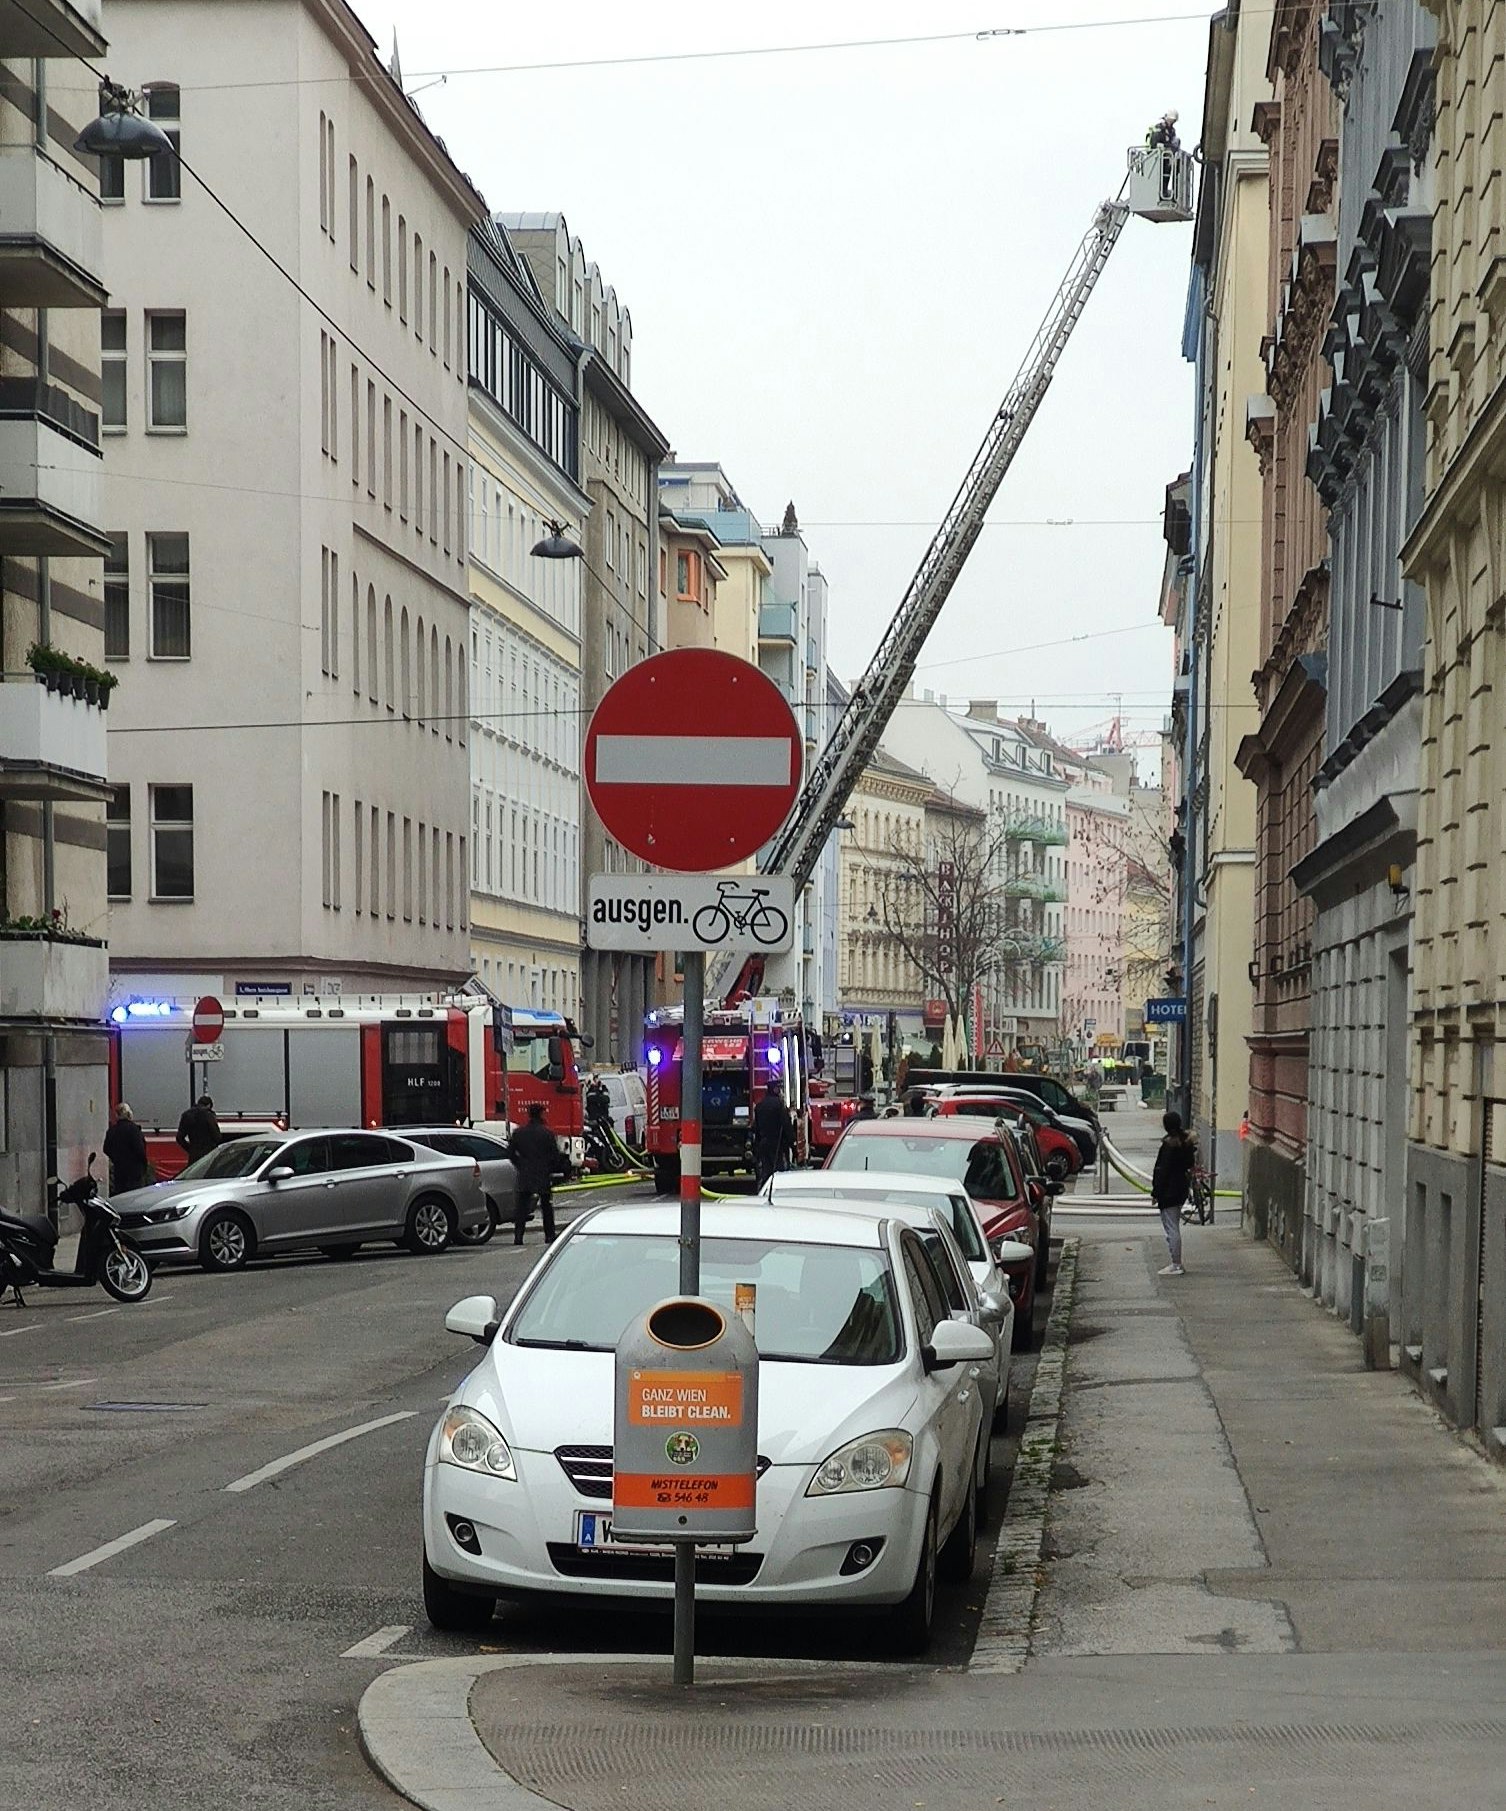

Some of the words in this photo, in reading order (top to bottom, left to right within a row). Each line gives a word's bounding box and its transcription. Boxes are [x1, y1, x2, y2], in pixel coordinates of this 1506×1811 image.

[593, 898, 689, 932] ausgen.
[407, 1077, 425, 1087] HLF
[642, 1388, 674, 1402] GANZ
[676, 1388, 706, 1402] WIEN
[641, 1404, 685, 1418] BLEIBT
[687, 1405, 731, 1419] CLEAN.
[651, 1479, 719, 1490] MISTTELEFON
[674, 1492, 693, 1503] 546
[695, 1492, 709, 1503] 48
[584, 1533, 592, 1542] A
